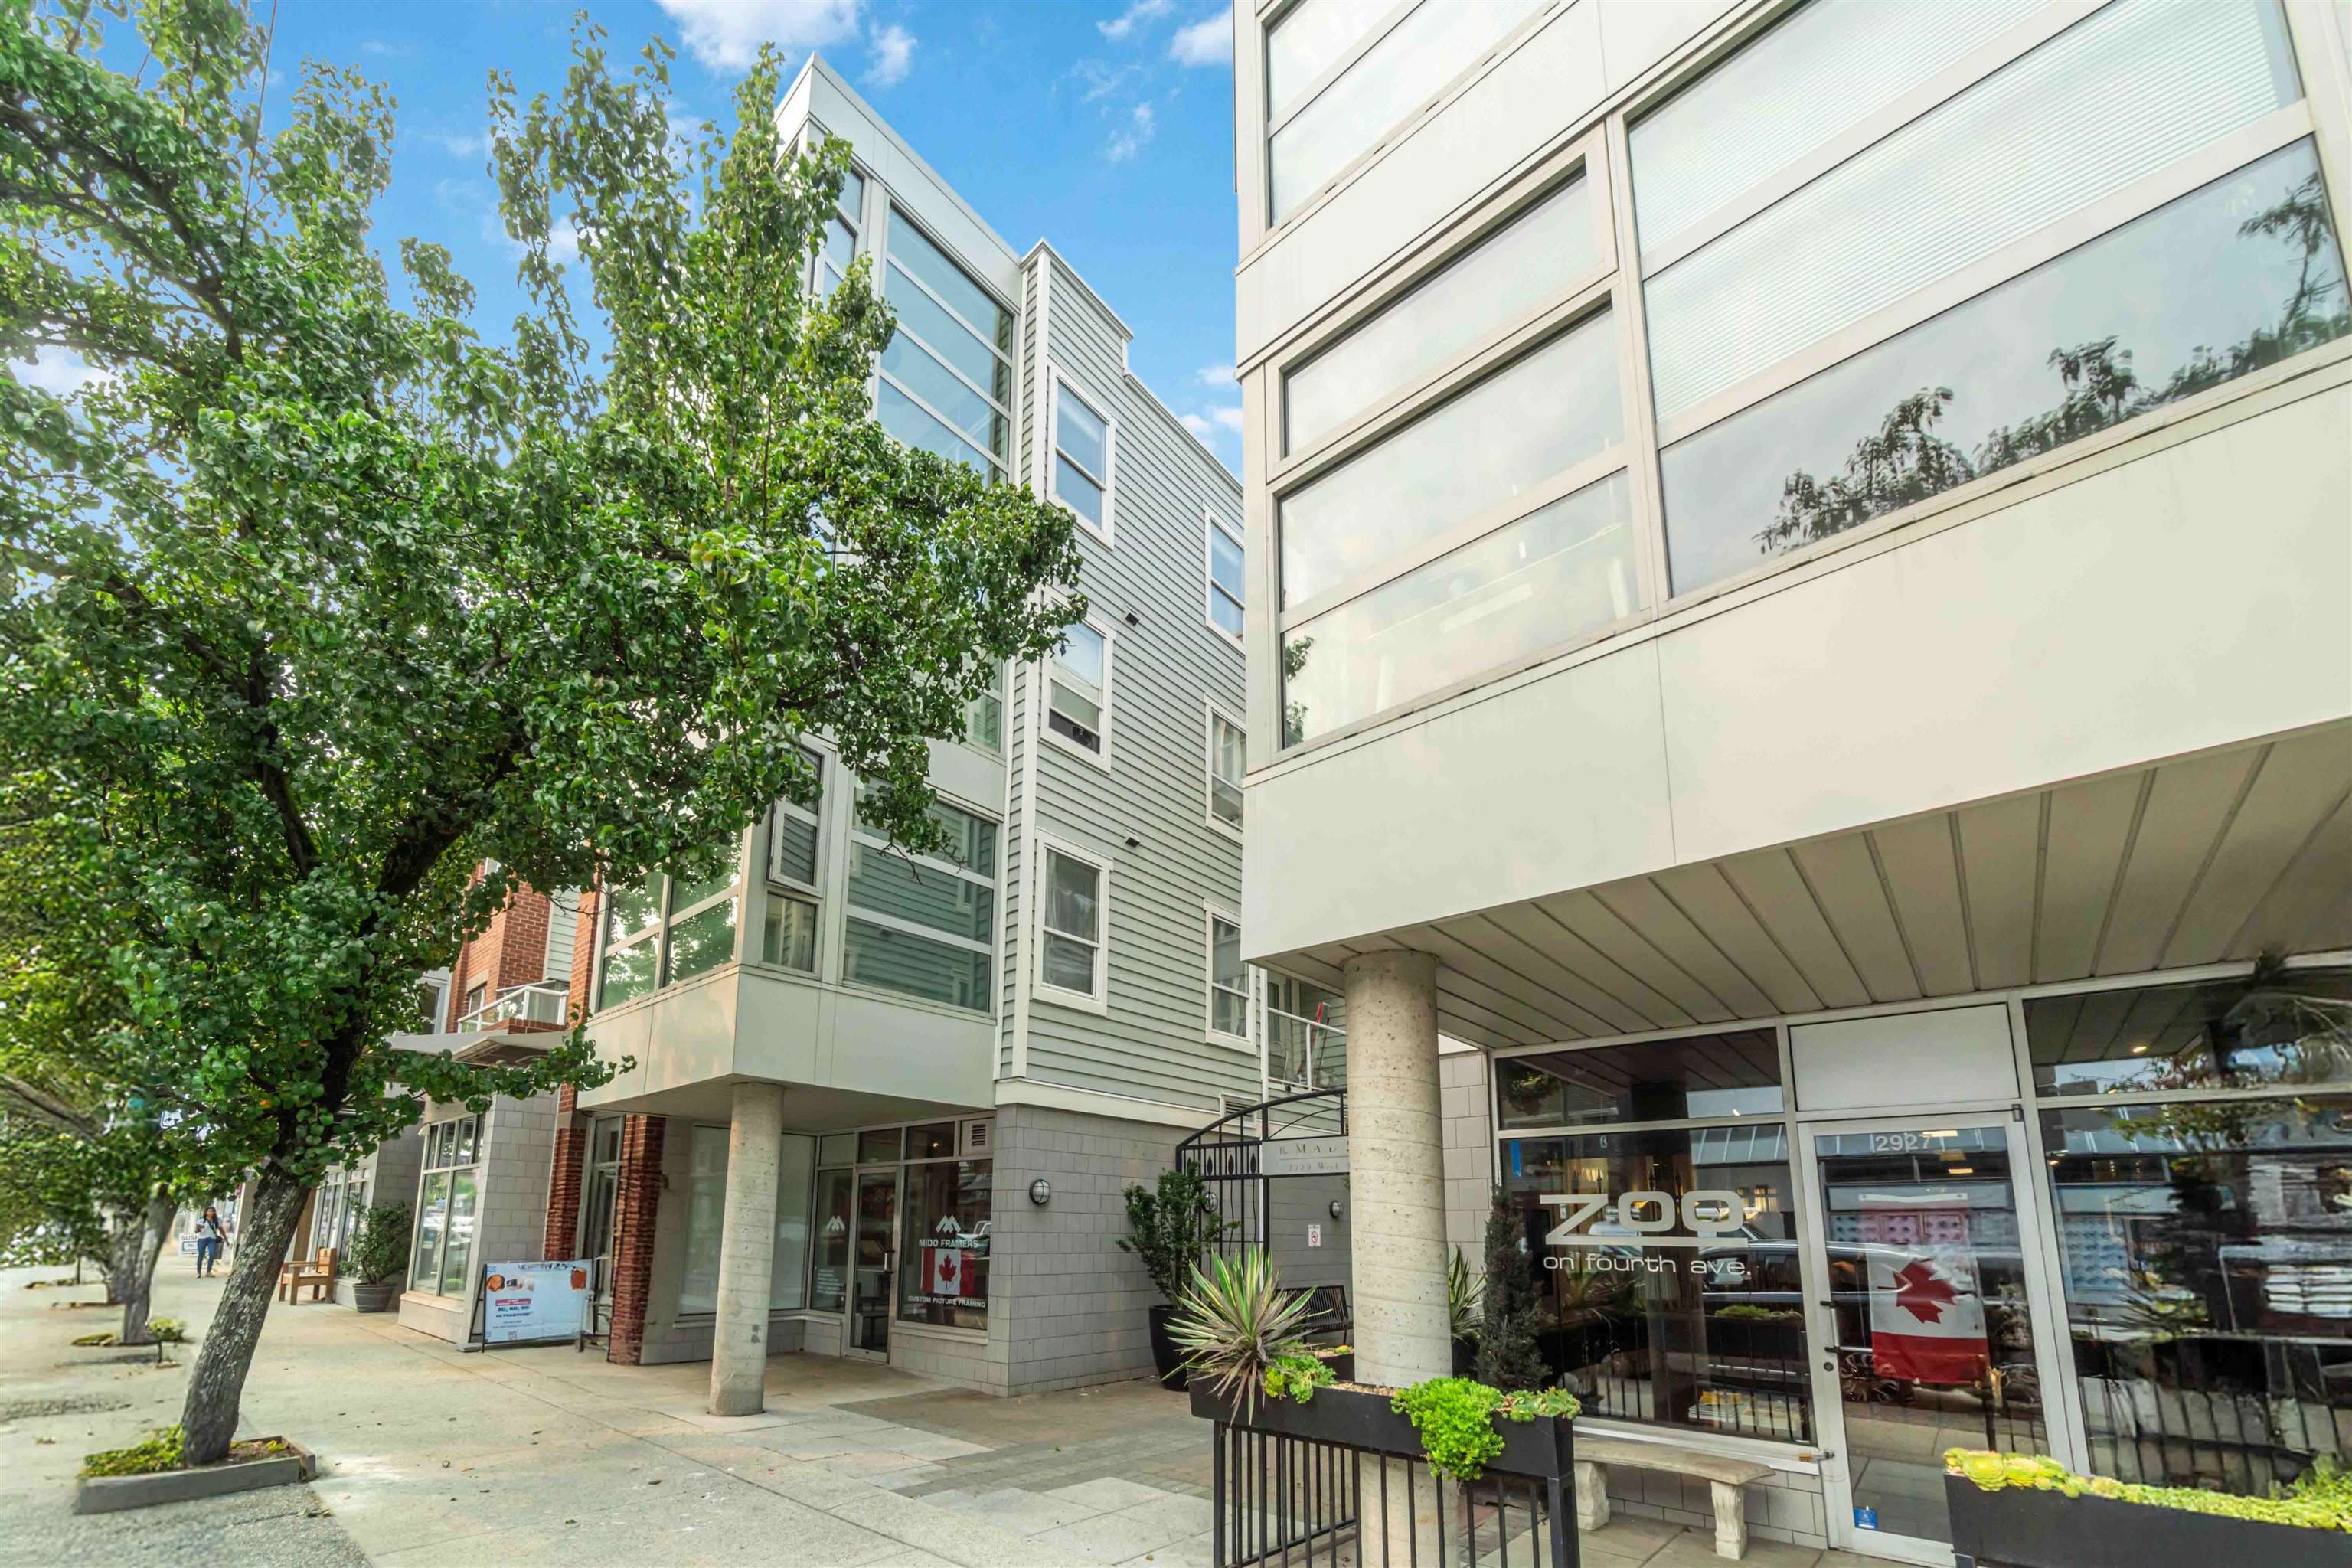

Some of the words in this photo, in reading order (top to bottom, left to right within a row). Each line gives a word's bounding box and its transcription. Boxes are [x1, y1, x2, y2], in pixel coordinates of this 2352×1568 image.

[1875, 1134, 1931, 1151] 2927
[919, 1239, 939, 1247] MIDO
[940, 1239, 978, 1248] FRAMERS
[1544, 1256, 1575, 1270] on
[1586, 1253, 1676, 1272] fourth
[1690, 1259, 1752, 1276] ave.
[908, 1295, 931, 1303] CUSTOM
[933, 1296, 957, 1305] PICTURE
[959, 1298, 986, 1308] FRAMING
